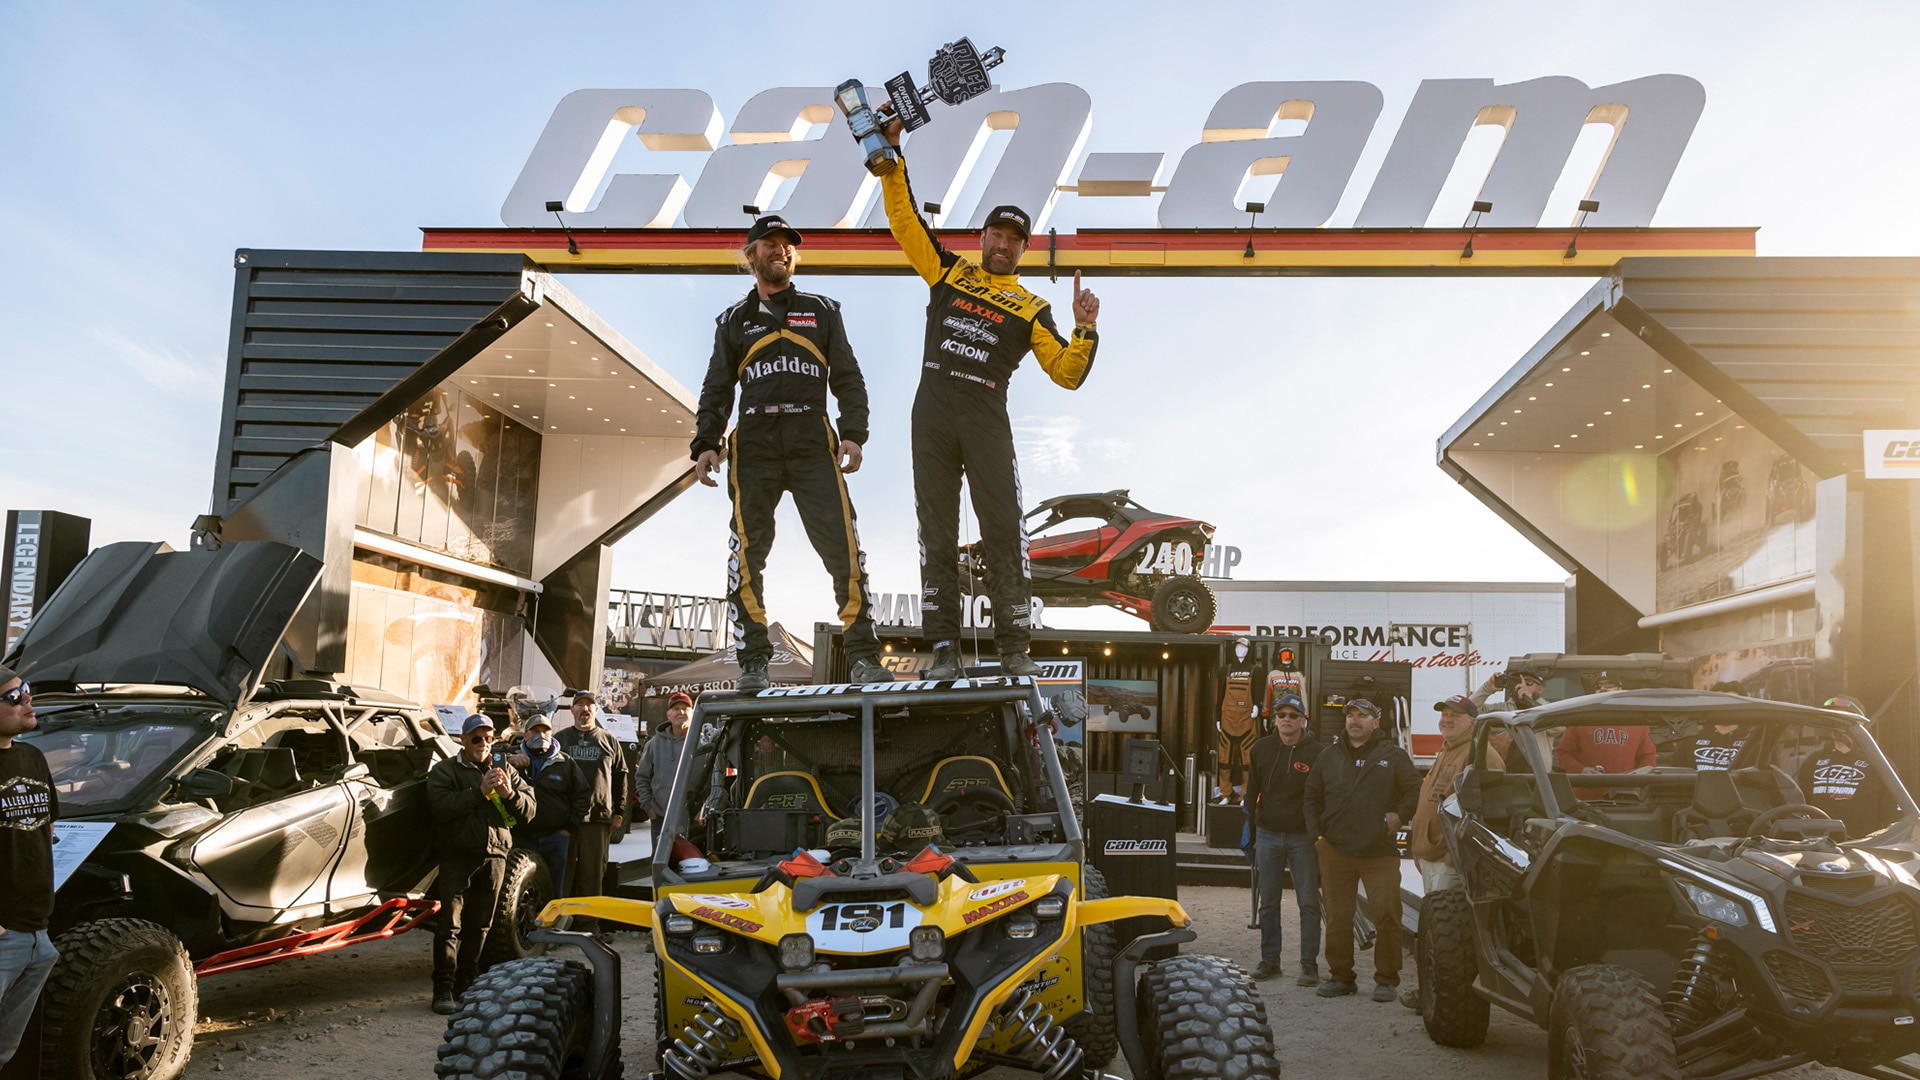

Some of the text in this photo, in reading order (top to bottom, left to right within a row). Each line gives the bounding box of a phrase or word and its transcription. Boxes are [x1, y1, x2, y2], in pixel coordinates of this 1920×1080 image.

[951, 43, 990, 94] RACE
[891, 90, 911, 121] WINNER
[897, 85, 918, 119] OVERALL
[501, 75, 1706, 233] can-am
[954, 277, 1024, 313] can-am
[951, 297, 1005, 324] MAXXIS
[944, 317, 999, 345] MOMENTUM
[744, 355, 821, 383] Madden
[1136, 541, 1243, 578] 240 HP
[10, 522, 39, 632] LEGENDARY
[872, 592, 996, 628] MAVIC
[660, 683, 700, 695] DANG
[703, 680, 738, 691] BROT
[1593, 728, 1629, 747] GAP
[1, 792, 49, 808] ALLEGIANCE
[1104, 839, 1167, 850] can-am
[690, 905, 764, 934] MAXXIS
[819, 902, 906, 931] 191
[962, 890, 1030, 925] MAXXIS
